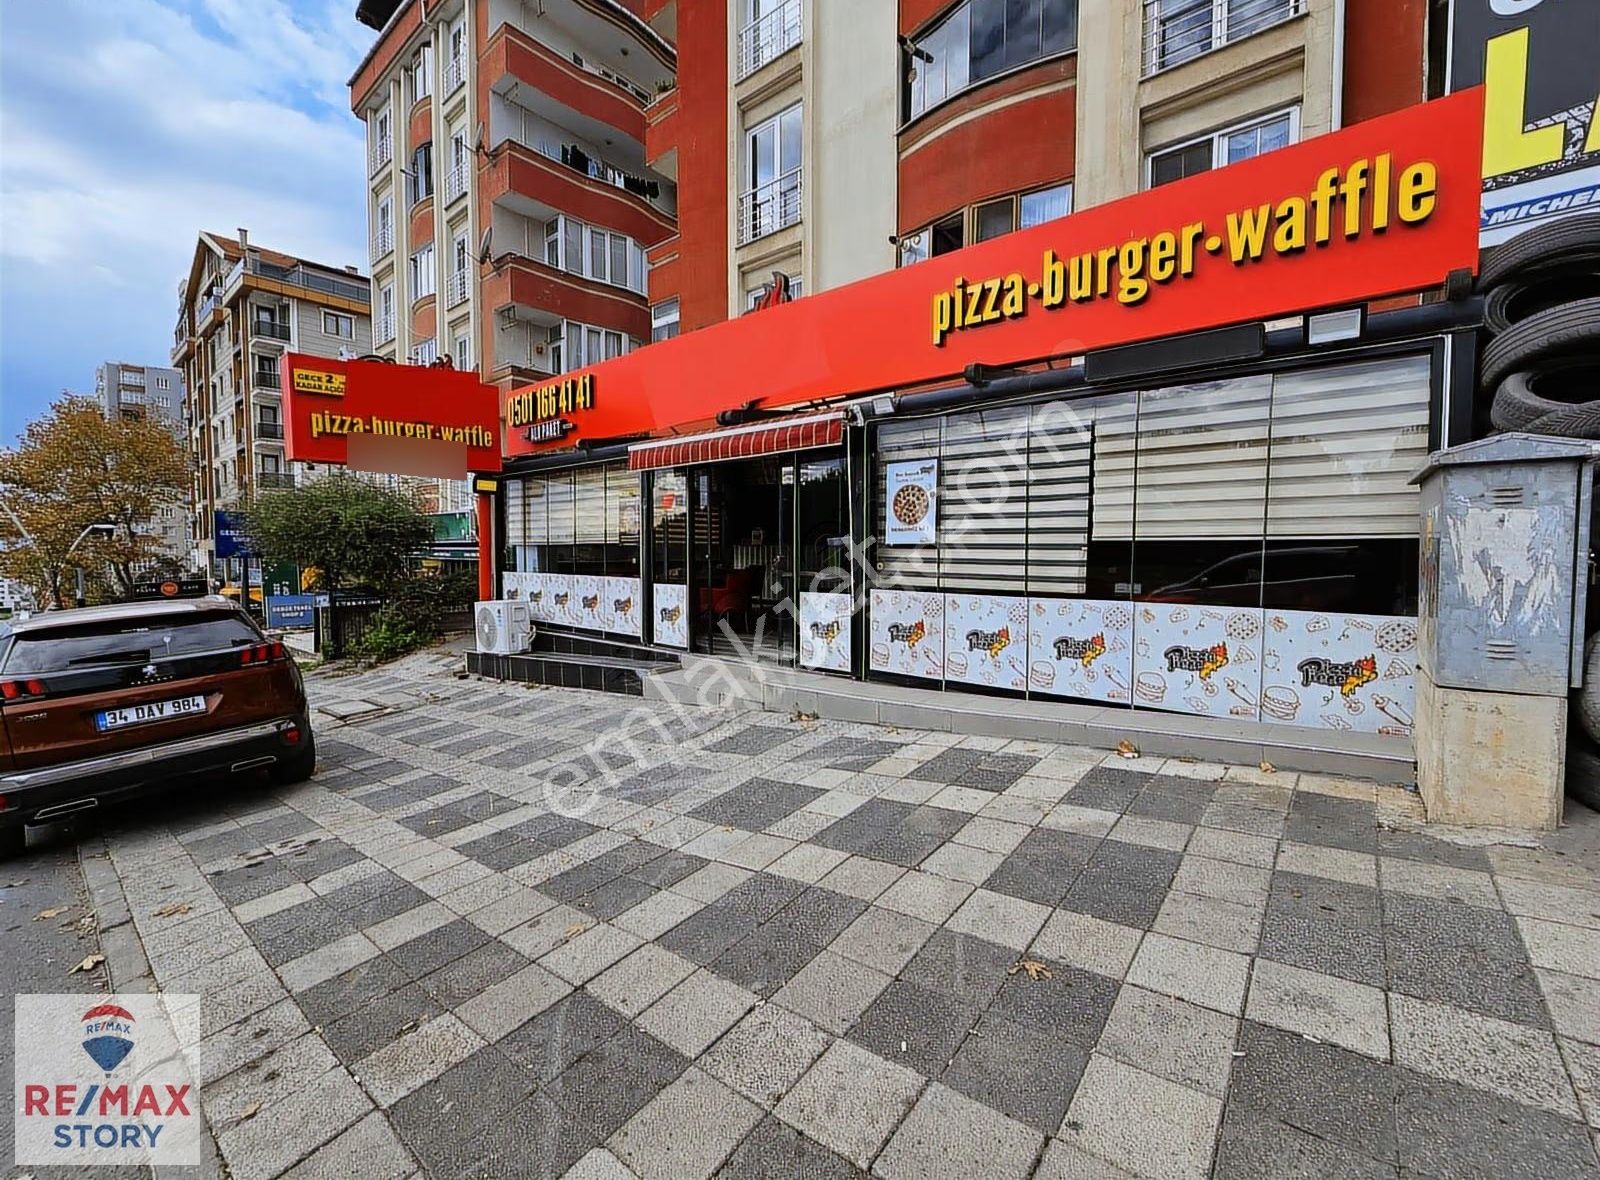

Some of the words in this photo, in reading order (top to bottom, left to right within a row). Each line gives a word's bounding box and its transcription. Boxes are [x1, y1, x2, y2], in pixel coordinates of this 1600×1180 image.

[507, 391, 534, 427] 0501
[536, 383, 556, 419] 166
[559, 378, 572, 413] 41
[576, 374, 591, 409] 41
[107, 707, 129, 725] 34
[135, 702, 166, 720] DAV
[172, 697, 200, 714] 984
